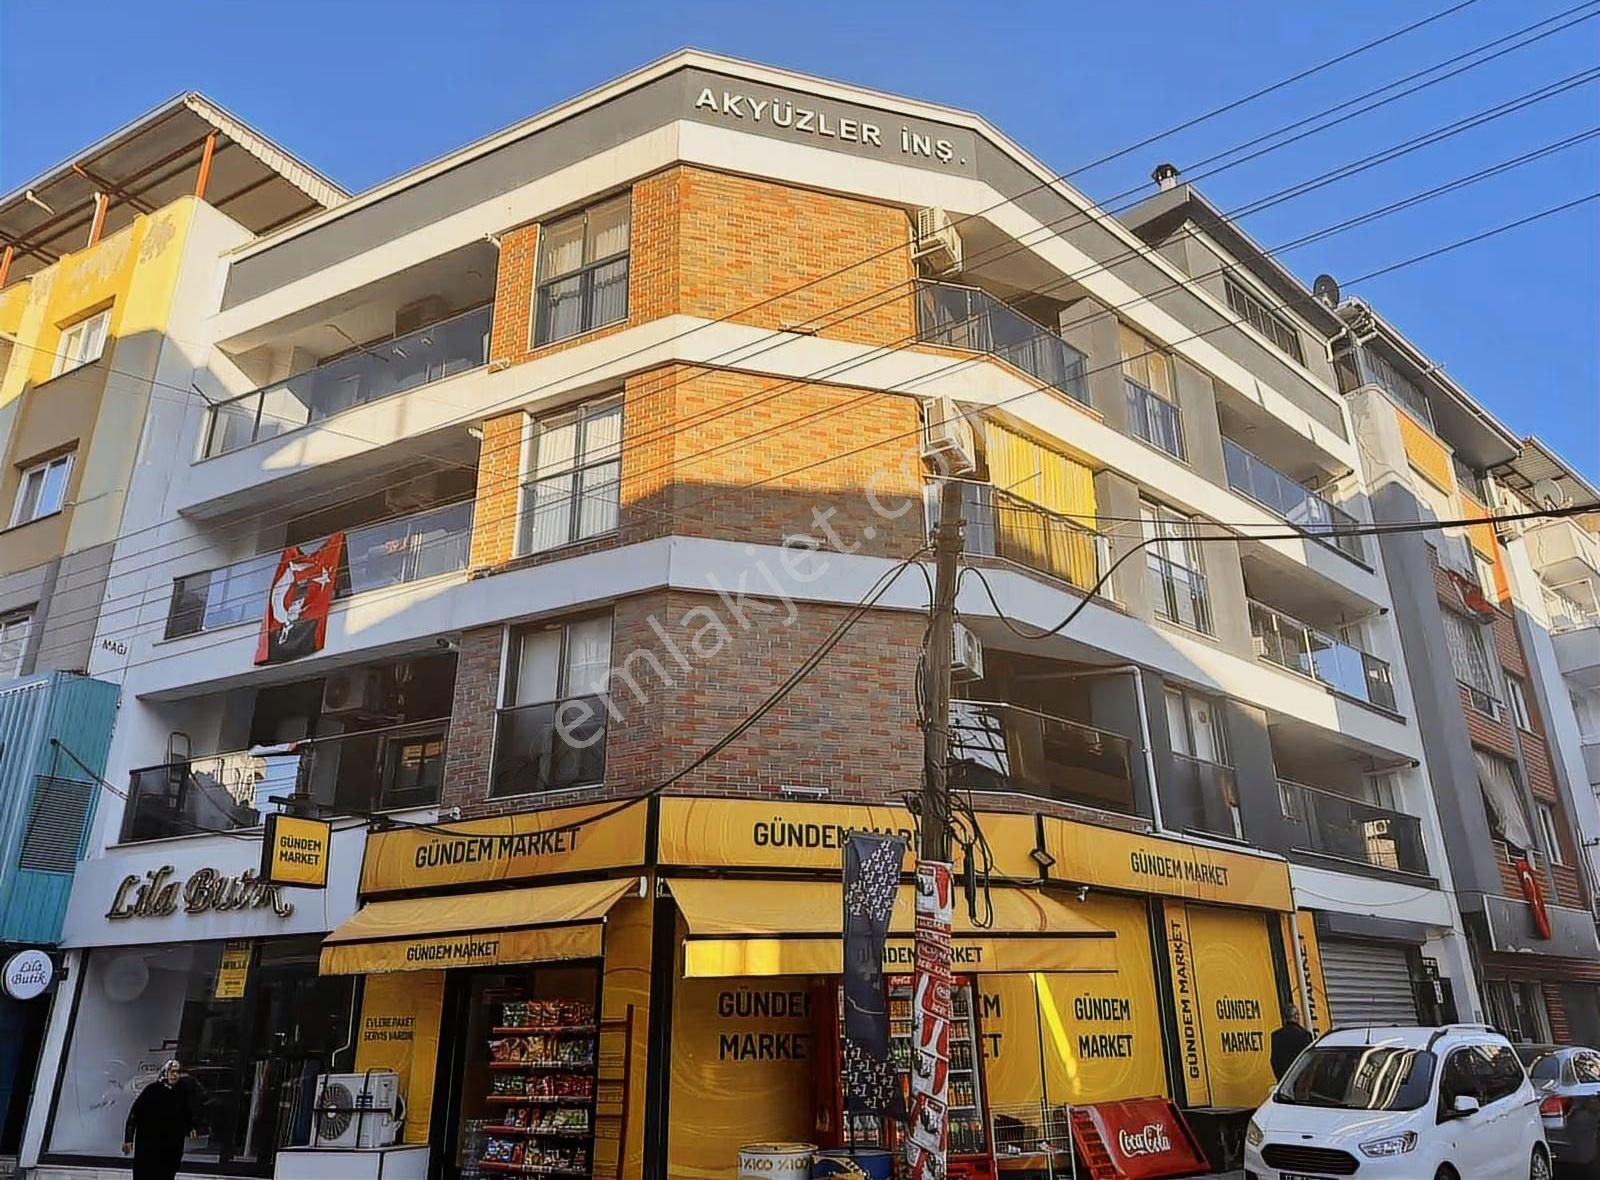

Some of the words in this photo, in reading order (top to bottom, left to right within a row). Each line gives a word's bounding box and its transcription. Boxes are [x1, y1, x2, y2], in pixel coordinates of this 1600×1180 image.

[695, 87, 882, 146] AKYÜZLER
[280, 835, 322, 851] GÜNDEM
[415, 838, 493, 868] GÜNDEM
[498, 827, 581, 860] MARKET
[279, 850, 321, 866] MARKET
[1130, 848, 1183, 880] GÜNDEM
[1184, 861, 1229, 886] MARKET
[105, 864, 182, 920] Lila
[407, 942, 452, 962] GÜNDEM
[453, 940, 499, 959] MARKET
[1171, 920, 1189, 994] MARKET
[1074, 992, 1131, 1021] GÜNDEM
[1216, 995, 1262, 1020] GÜNDEM
[719, 1032, 809, 1062] MARKE
[1078, 1034, 1133, 1059] MARKET
[1181, 999, 1200, 1079] GÜNDEM
[1221, 1031, 1264, 1053] MARKET
